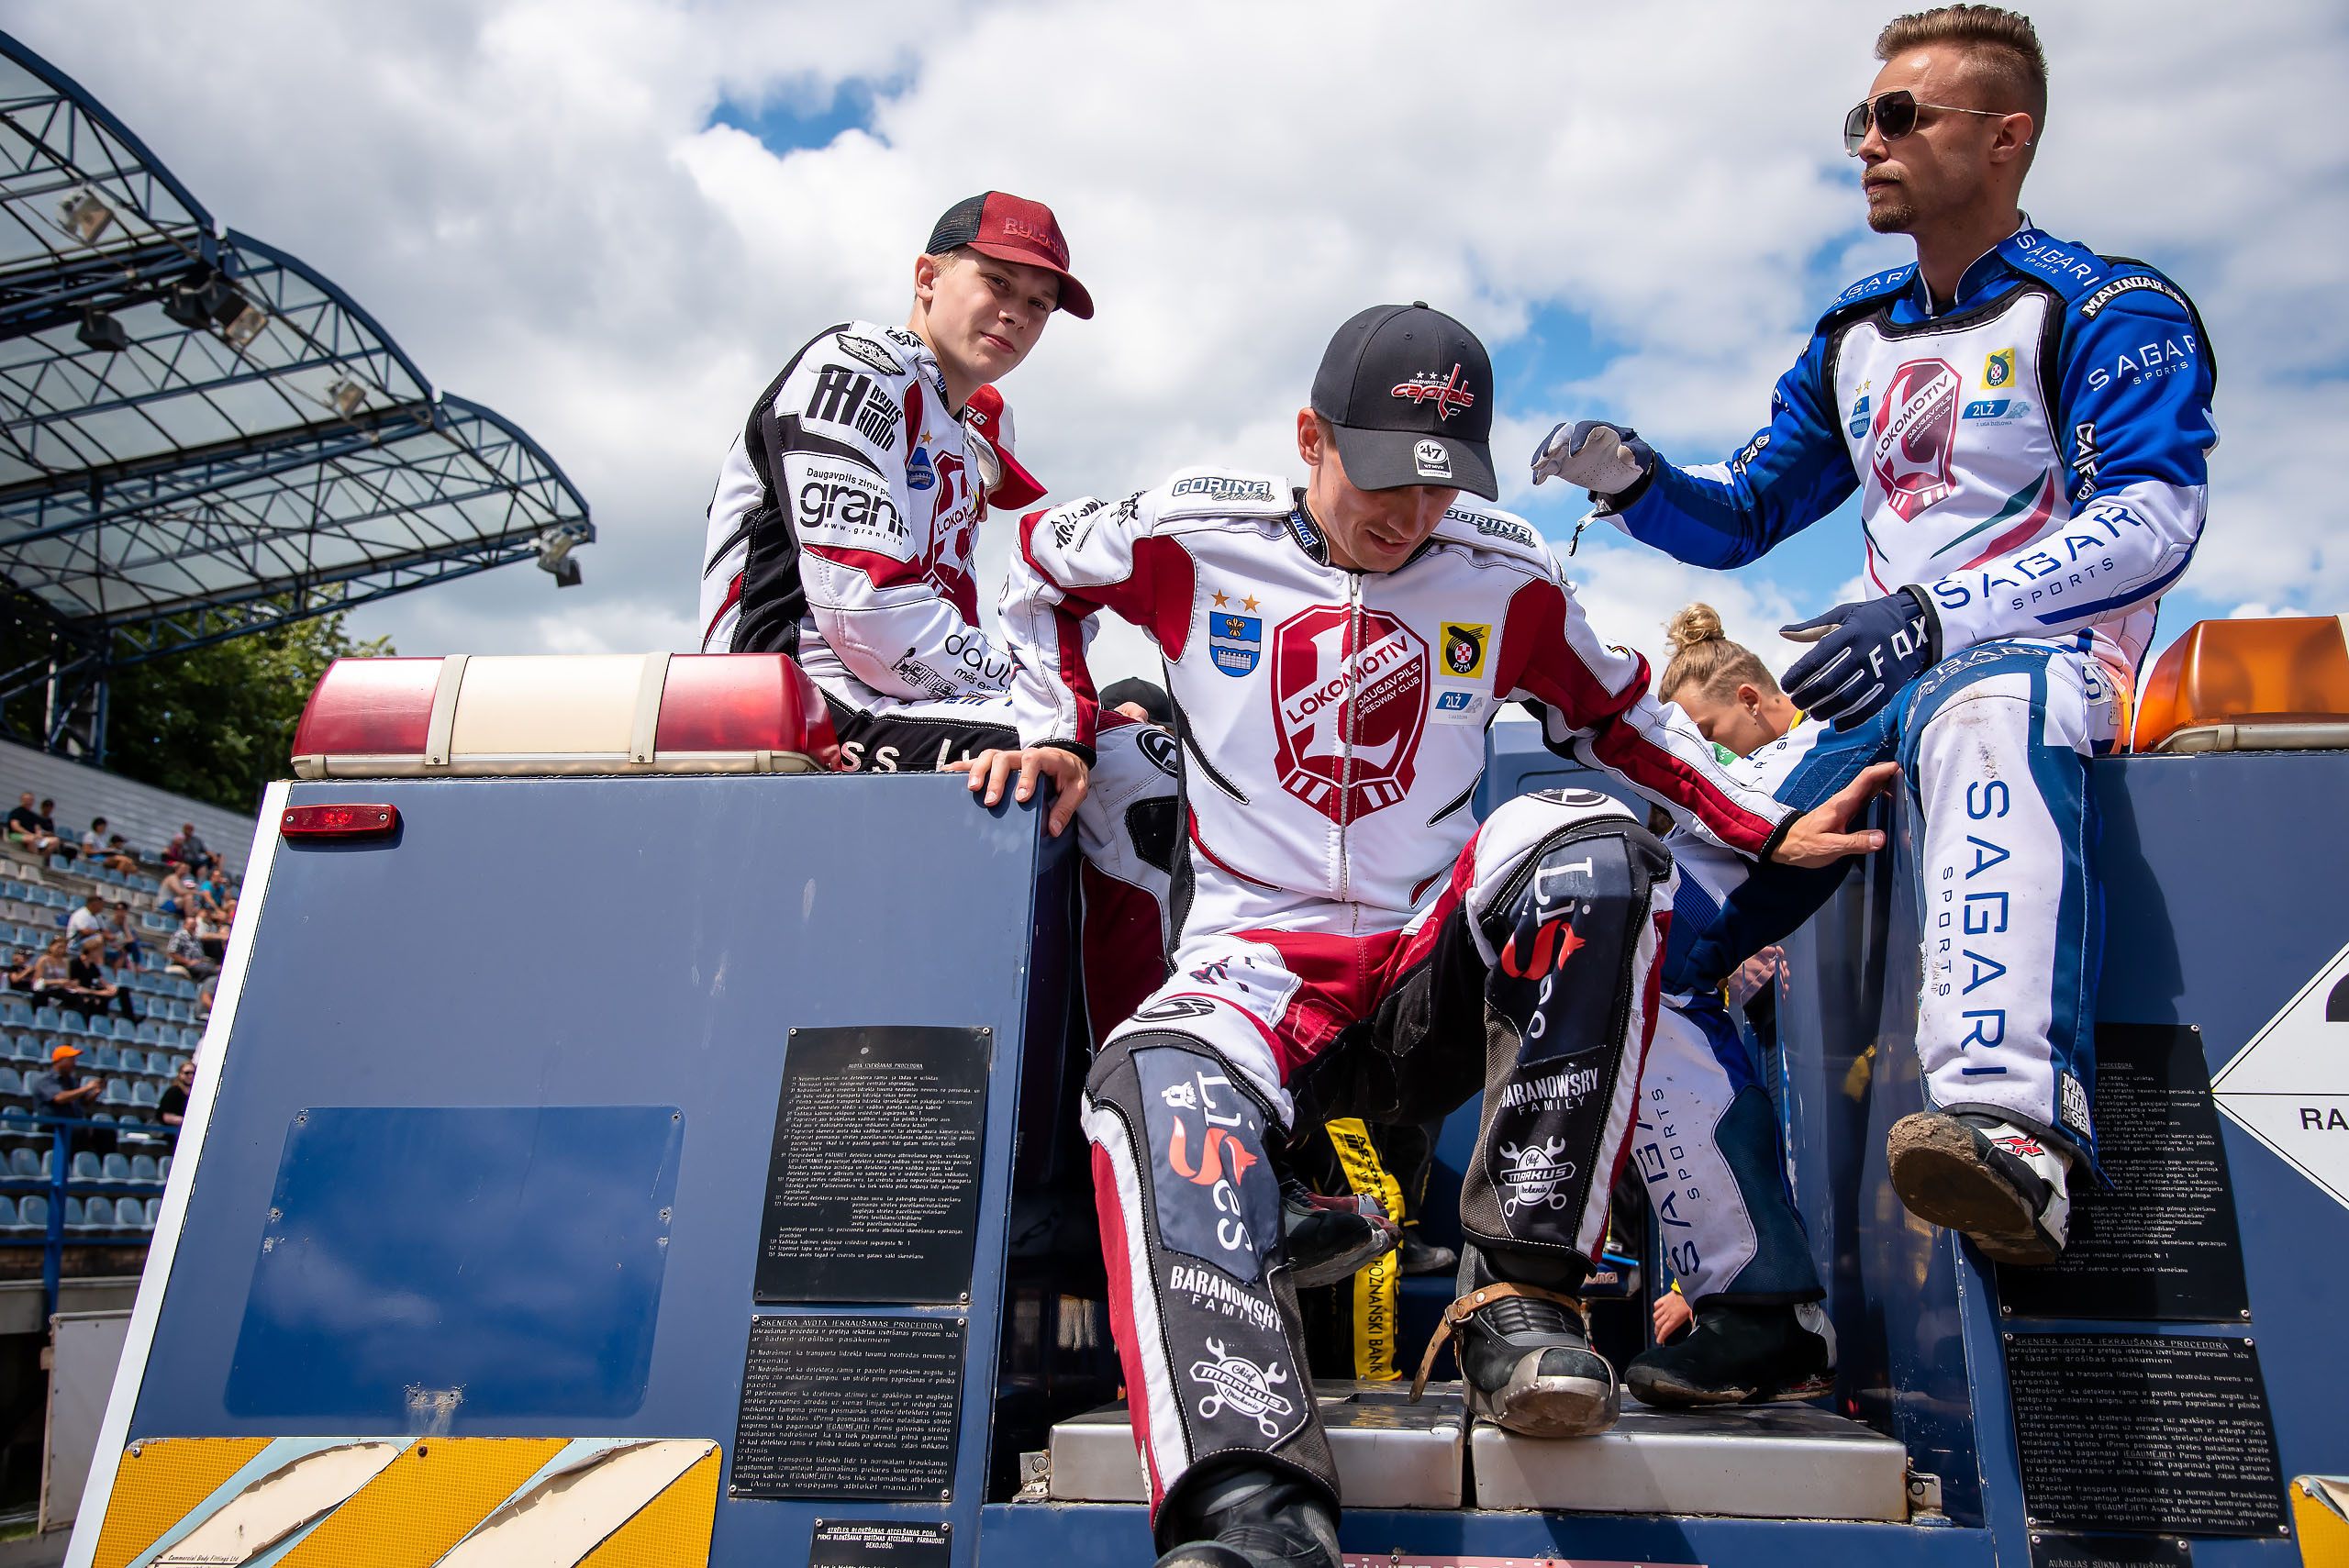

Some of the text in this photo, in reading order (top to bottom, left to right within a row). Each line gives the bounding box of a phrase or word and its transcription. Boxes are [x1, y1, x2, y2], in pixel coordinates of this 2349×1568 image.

[2017, 235, 2100, 286] SAGARI
[2023, 257, 2058, 274] SPORTS
[1829, 266, 1912, 309] AGARI
[1408, 378, 1448, 387] WASHINGTON
[1989, 377, 2003, 386] PZM
[2133, 361, 2188, 385] SPORTS
[1876, 373, 1949, 460] LOKOMOTIV
[1906, 394, 1953, 440] DAUGAVPILS
[1972, 401, 1995, 417] 2LŻ
[806, 467, 857, 484] Daugavpils
[858, 478, 879, 492] ziņu
[1172, 476, 1271, 497] GORINA
[1211, 491, 1275, 503] Brothers
[1442, 507, 1532, 539] GORINA
[2012, 558, 2114, 611] SPORTS
[1868, 616, 1929, 679] FOX
[954, 668, 978, 684] mēs
[1286, 635, 1409, 725] LOKOMOTIV
[1453, 661, 1471, 673] PZM
[1357, 662, 1421, 709] DAUGAVPILS
[1357, 677, 1421, 721] SPEEDWAY CLUB
[1445, 693, 1462, 709] 2LŻ
[1939, 866, 1954, 997] SPORTS
[1961, 780, 2010, 1076] SAGARI
[1518, 1095, 1585, 1116] FAMILY
[2299, 1107, 2349, 1130] RA
[1652, 1088, 1700, 1200] SPORTS
[1508, 1166, 1567, 1183] MARKUS
[1170, 1265, 1283, 1332] BARANOWSKY
[1192, 1293, 1266, 1331] FAMILY
[802, 1318, 828, 1327] AVOTA
[831, 1318, 888, 1328] IEKRAUŠANAS
[1368, 1339, 1384, 1374] BANK
[1200, 1366, 1283, 1409] MARKUS
[1231, 1364, 1257, 1383] Chief
[1224, 1387, 1260, 1411] Mechanic
